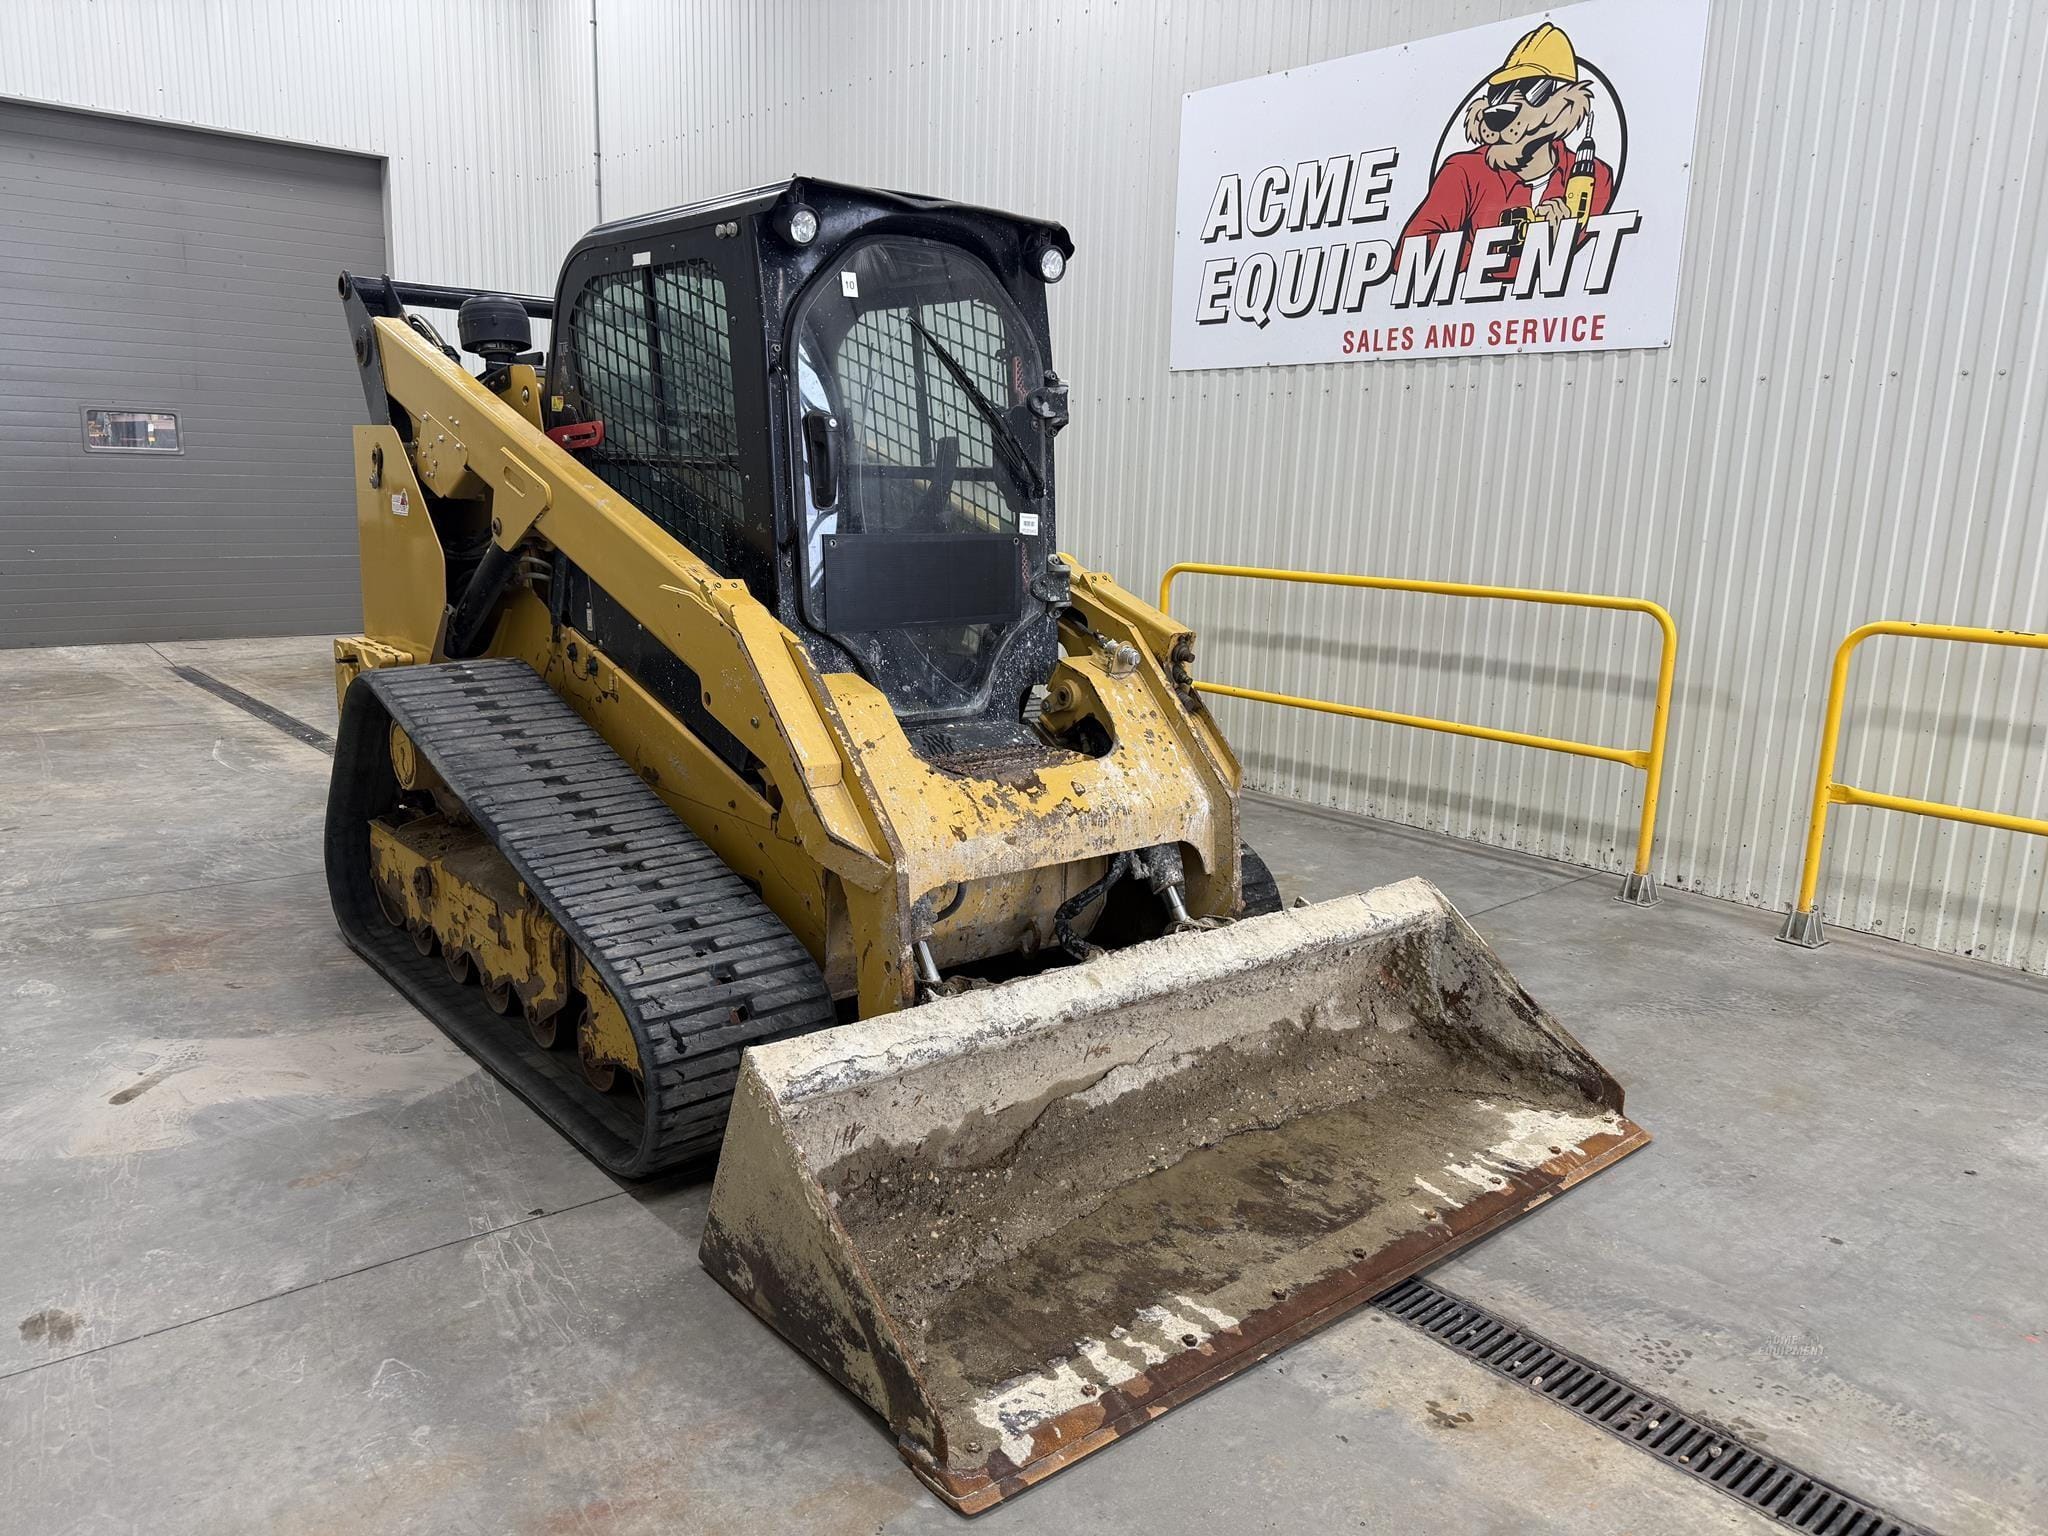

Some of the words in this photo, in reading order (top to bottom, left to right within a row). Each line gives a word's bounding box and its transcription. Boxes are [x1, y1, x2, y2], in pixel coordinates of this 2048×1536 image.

[1200, 147, 1399, 244] ACME
[845, 280, 855, 290] 10
[1196, 210, 1642, 330] EQUIPMENT
[1342, 326, 1414, 354] SALES
[1424, 322, 1475, 349] AND
[1487, 314, 1606, 346] SERVICE
